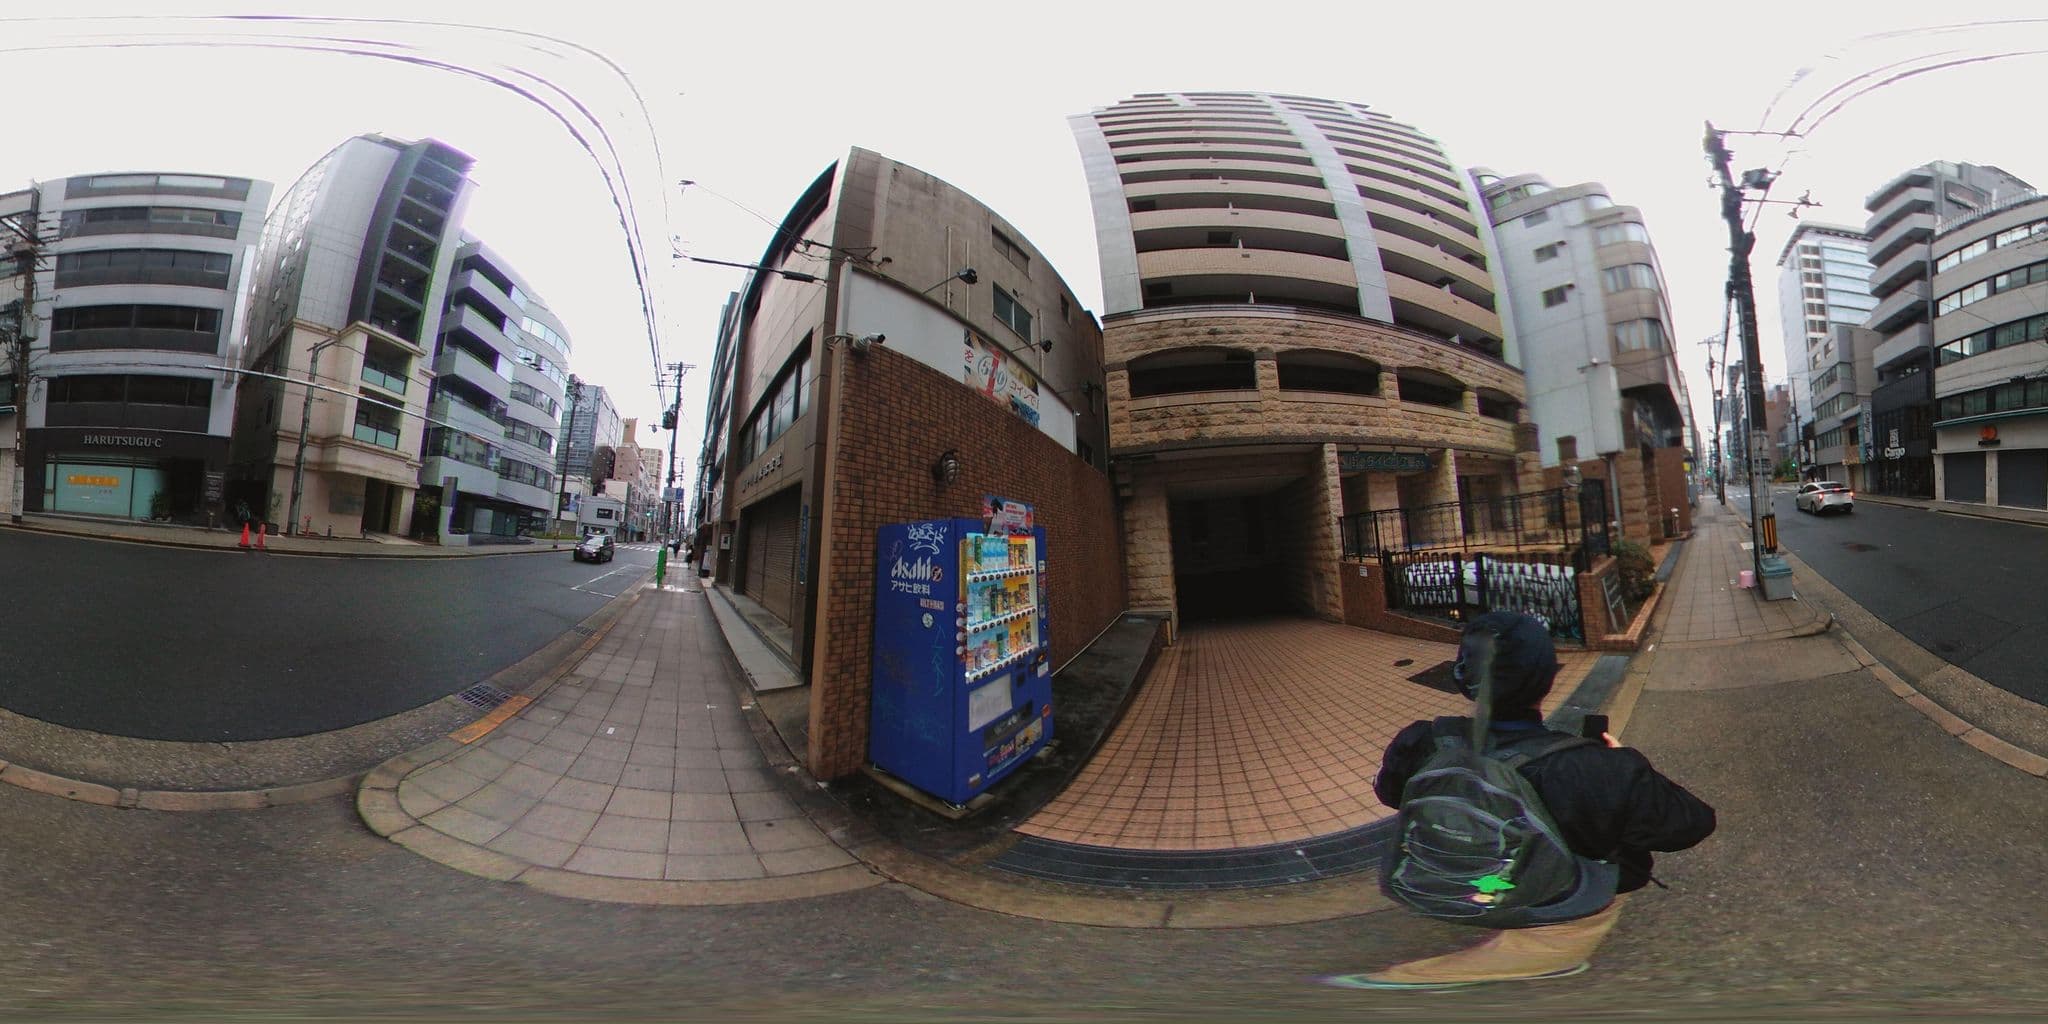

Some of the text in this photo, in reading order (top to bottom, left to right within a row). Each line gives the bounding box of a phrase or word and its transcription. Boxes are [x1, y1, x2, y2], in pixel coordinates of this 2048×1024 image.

[1884, 447, 1906, 459] Cargo
[891, 556, 931, 581] Asahi
[891, 580, 931, 595] アサヒ飲料
